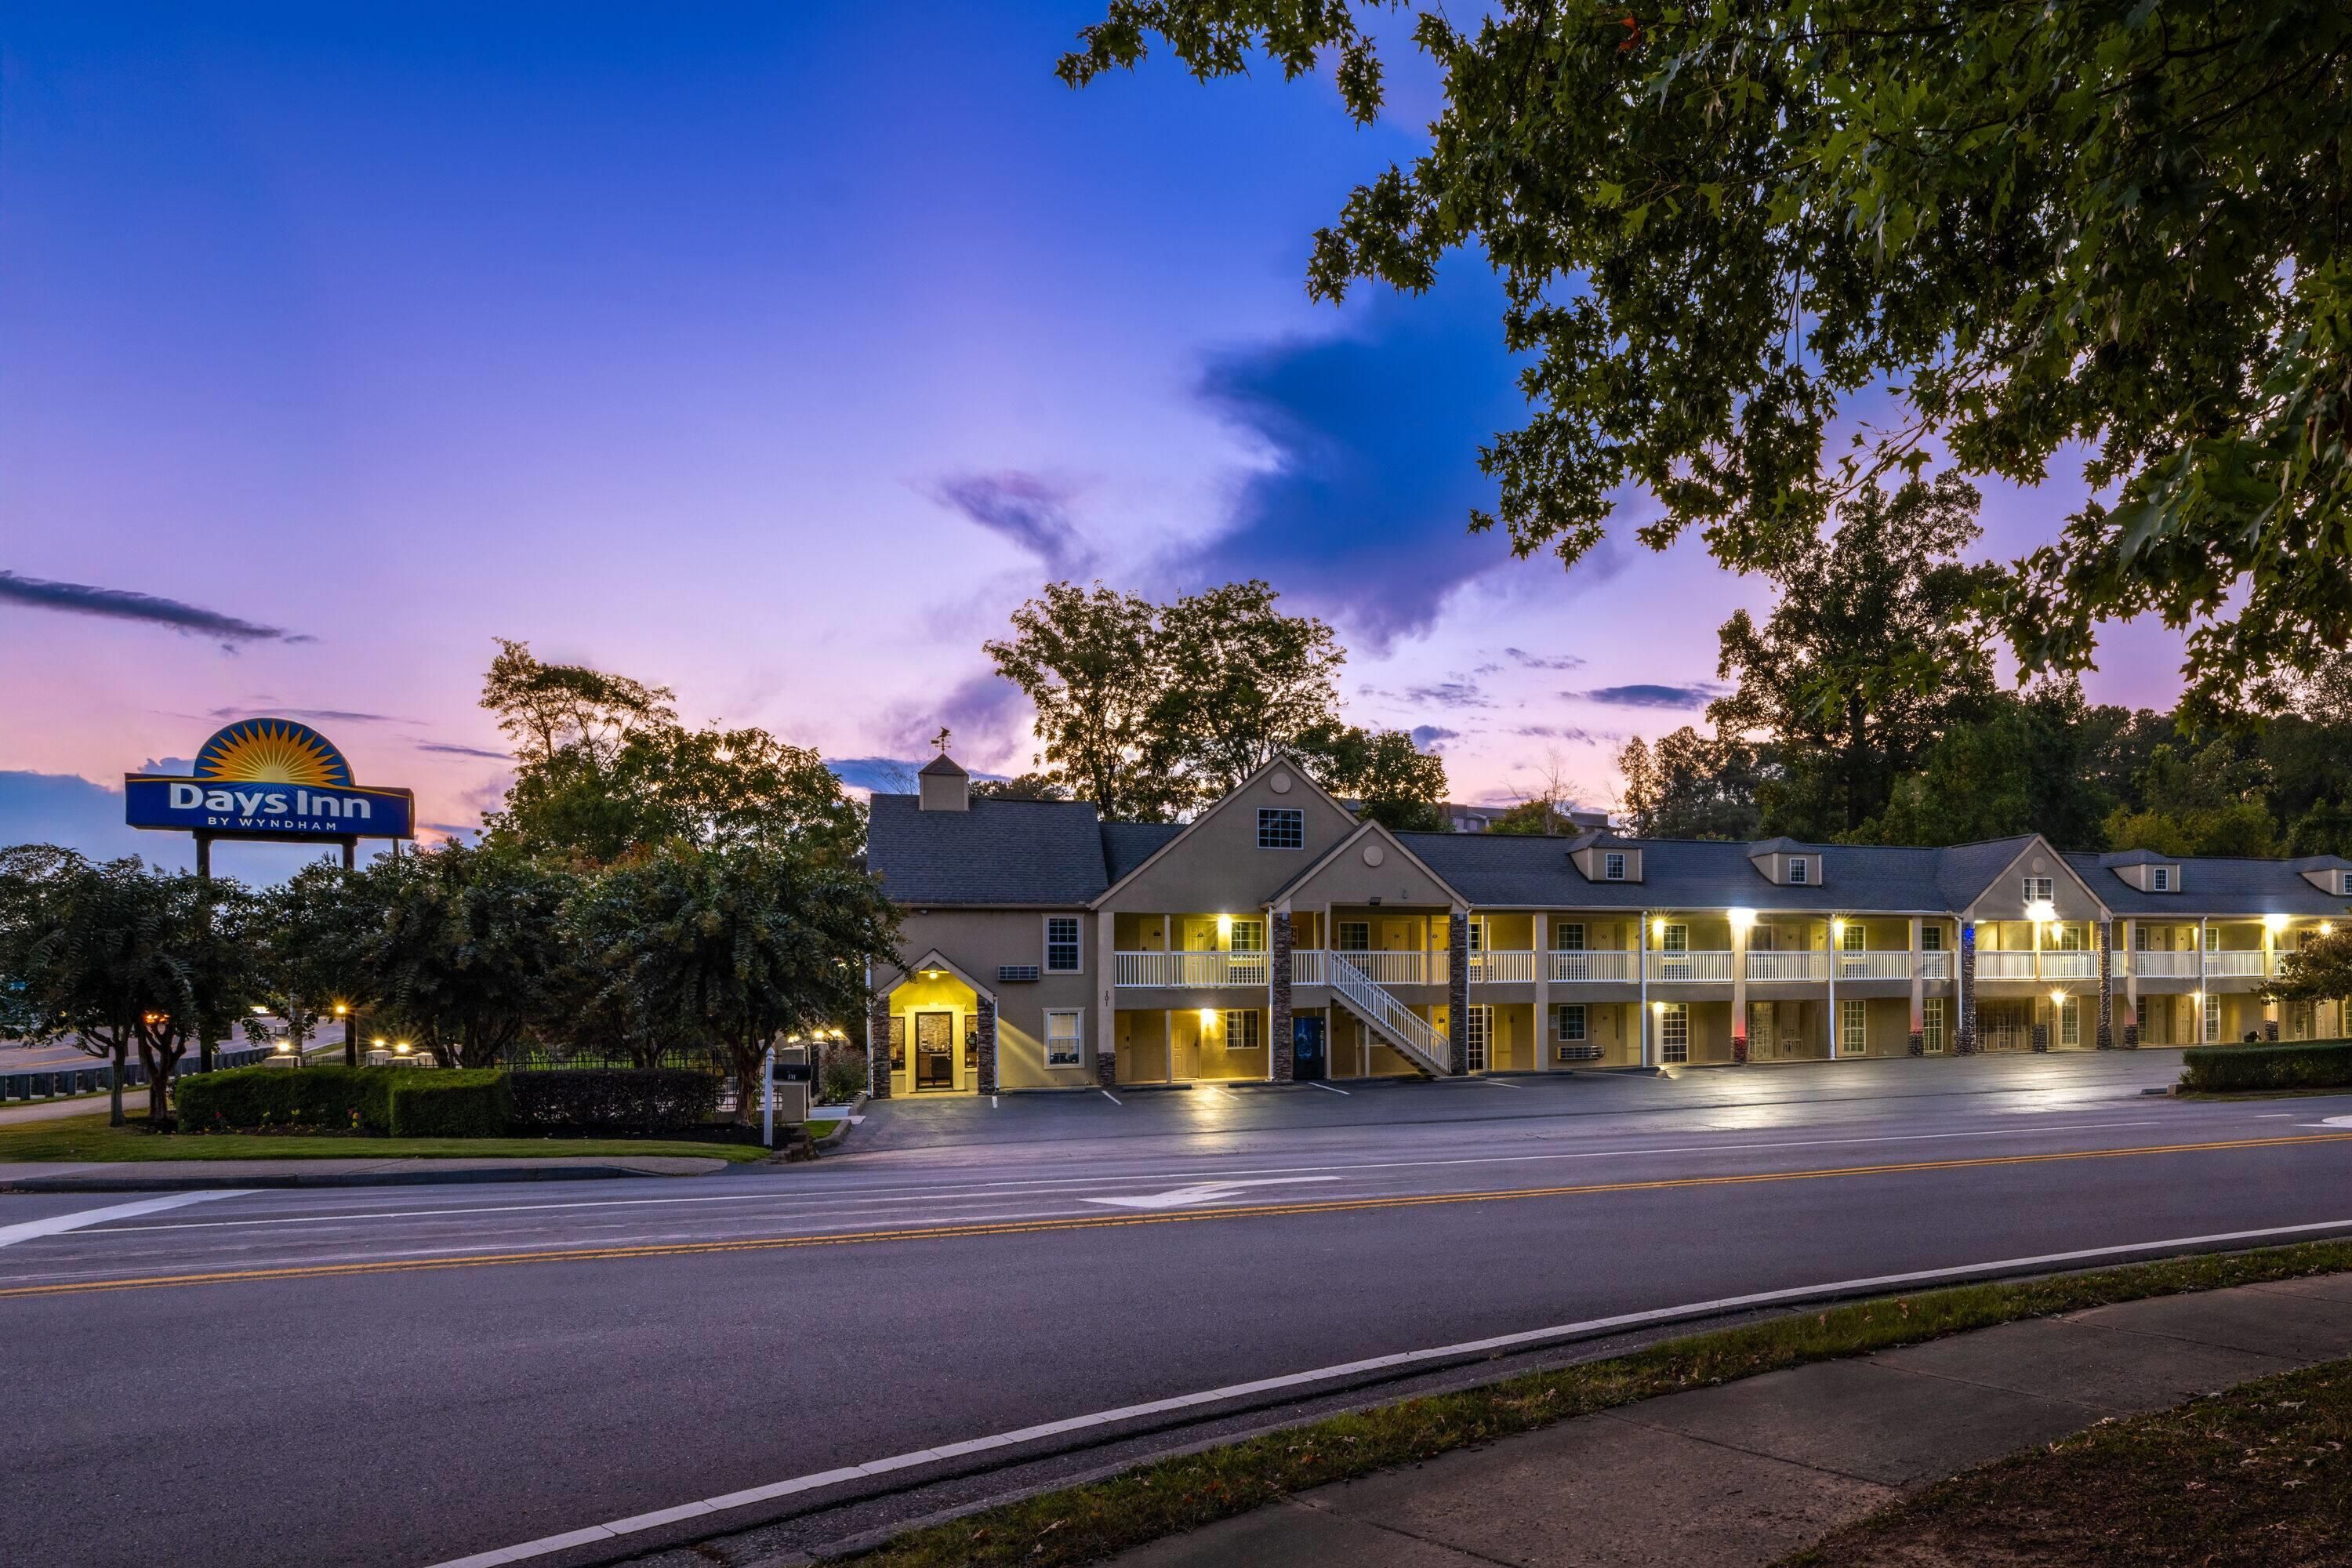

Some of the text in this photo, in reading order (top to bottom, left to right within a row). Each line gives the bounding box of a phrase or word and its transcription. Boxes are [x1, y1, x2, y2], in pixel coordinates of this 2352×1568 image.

[170, 782, 371, 818] Days Inn
[208, 817, 336, 831] BY WYNDHAM
